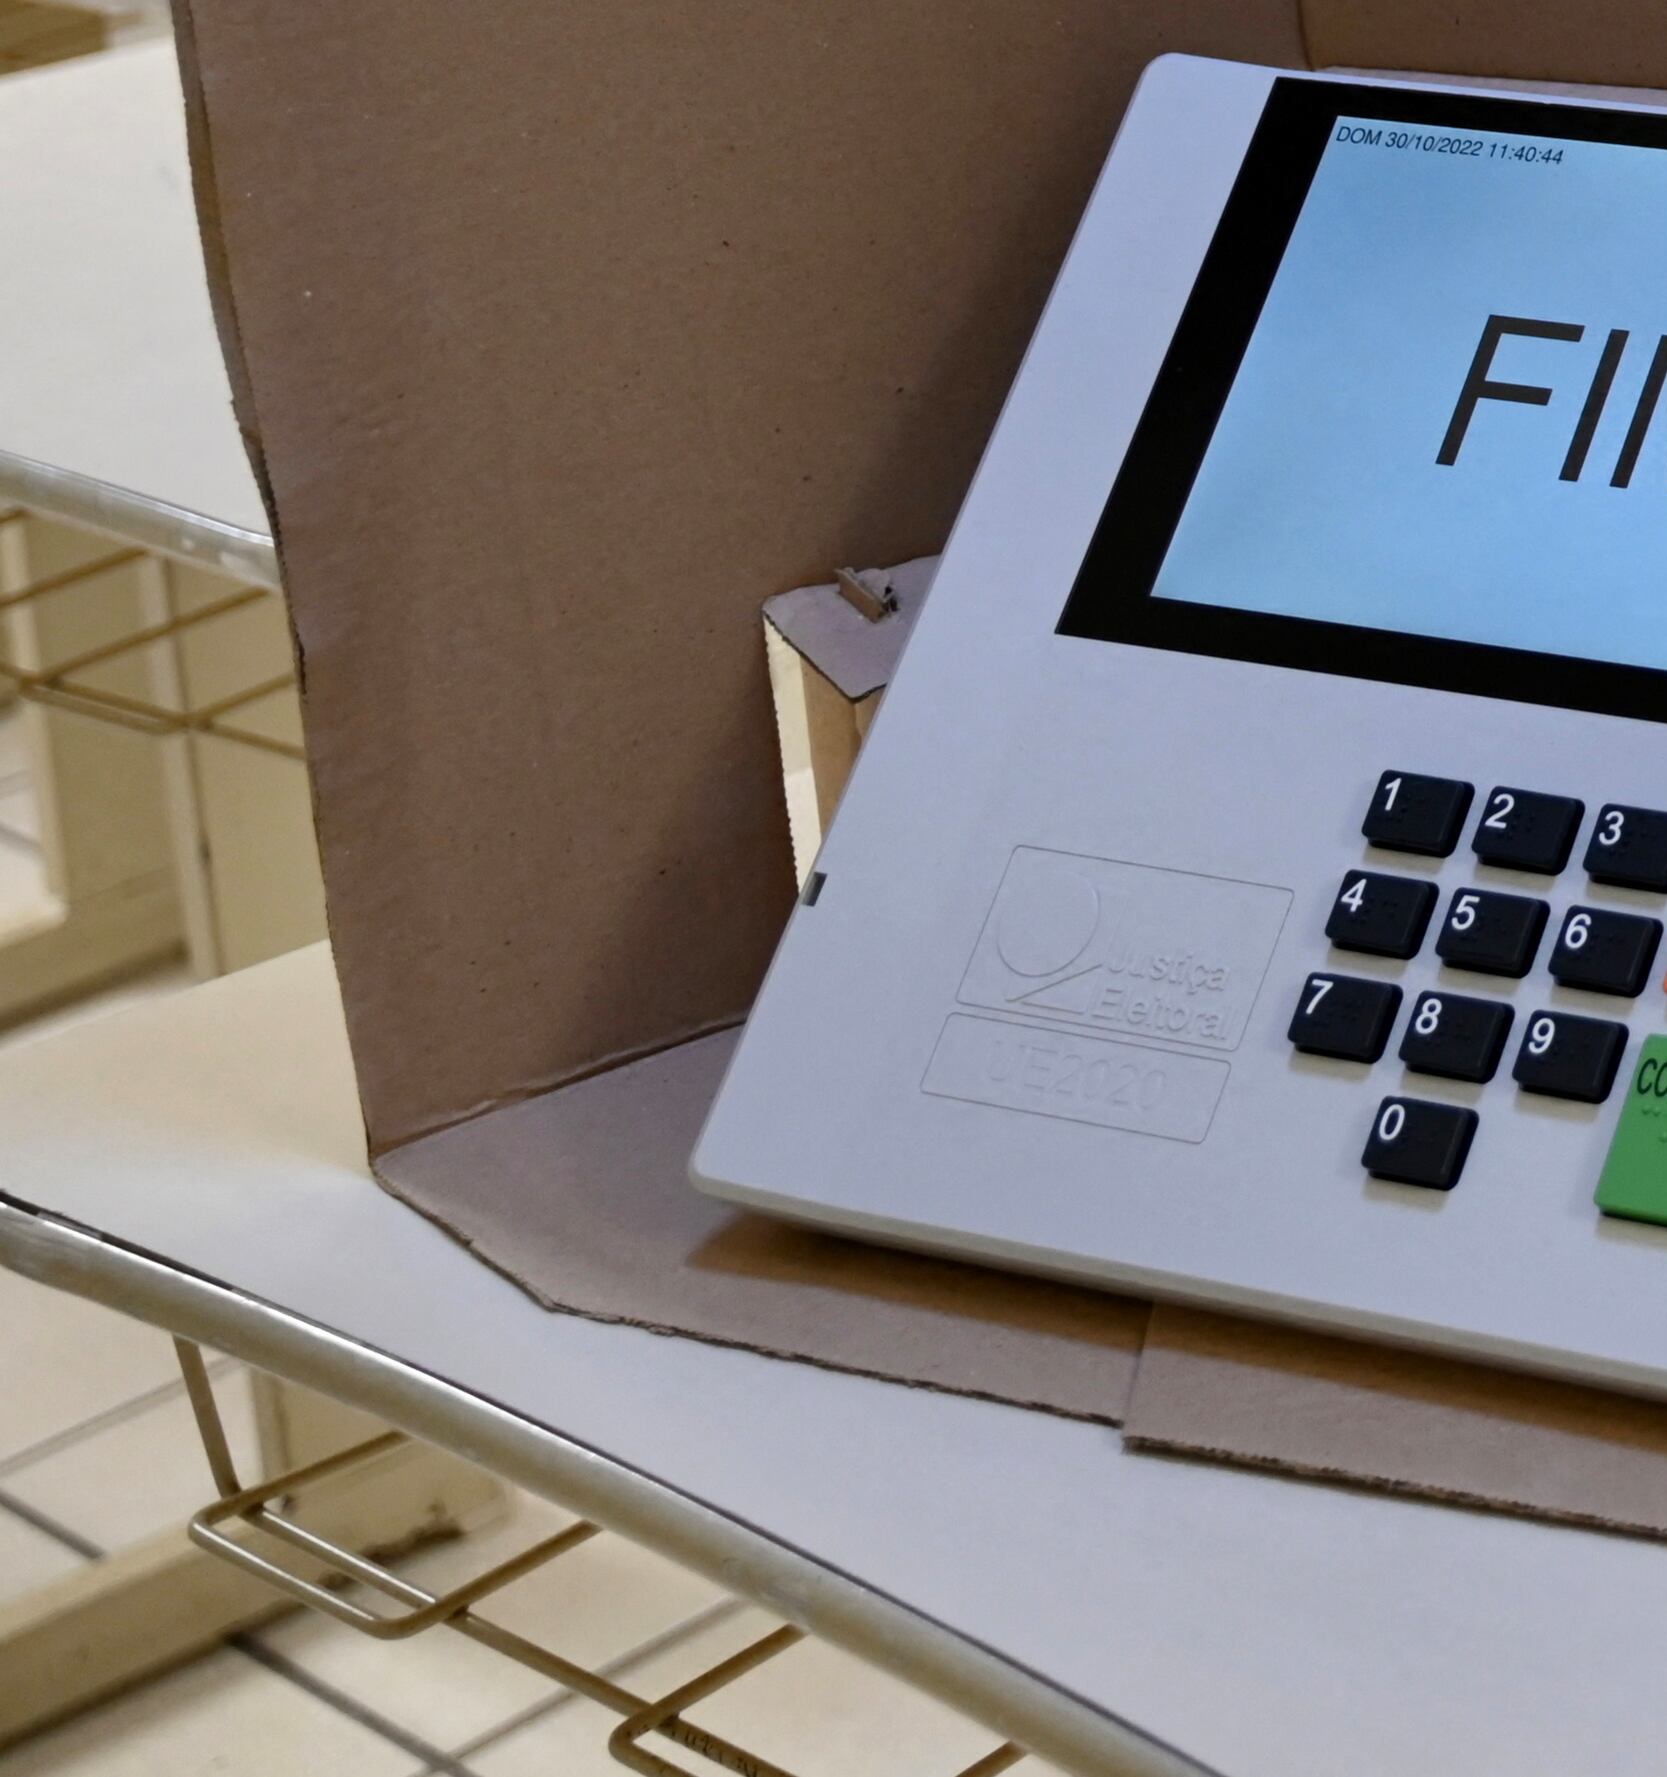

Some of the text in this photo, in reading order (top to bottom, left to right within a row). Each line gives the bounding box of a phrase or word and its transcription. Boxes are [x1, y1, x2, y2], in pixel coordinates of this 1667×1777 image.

[1335, 125, 1564, 165] DOM 30/10/2022 11:40:44
[1384, 777, 1402, 811] 1
[1484, 793, 1515, 829] 2
[1598, 810, 1625, 846] 3
[1340, 878, 1367, 913] 4
[1451, 894, 1481, 931] 5
[1564, 913, 1592, 950] 6
[1091, 987, 1234, 1042] Eleitoral
[1305, 978, 1334, 1015] 7
[1415, 998, 1443, 1035] 8
[1528, 1017, 1556, 1055] 9
[1378, 1103, 1406, 1141] 0
